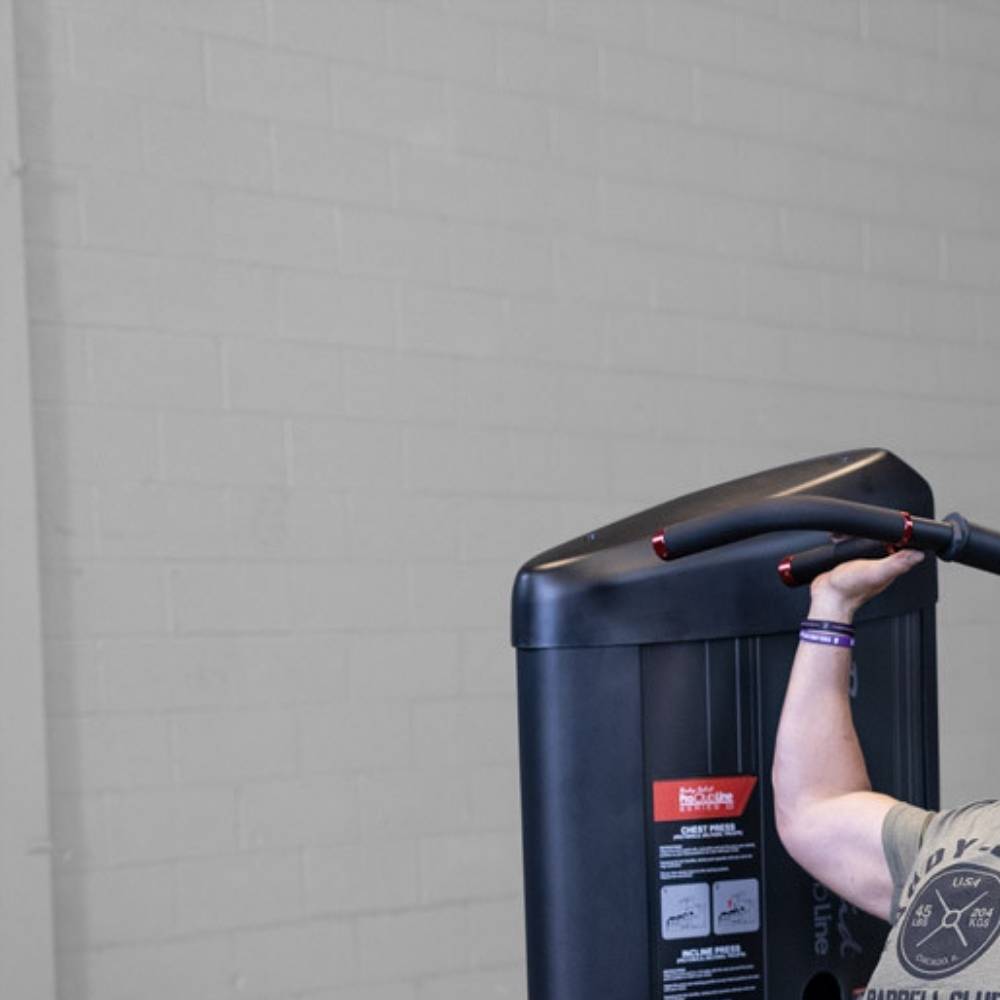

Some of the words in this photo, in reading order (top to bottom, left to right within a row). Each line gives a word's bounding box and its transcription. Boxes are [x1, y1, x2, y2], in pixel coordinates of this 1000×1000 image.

[680, 824, 707, 835] CHEST
[709, 822, 736, 833] PRESS
[915, 904, 933, 916] 45
[714, 944, 741, 956] PRESS
